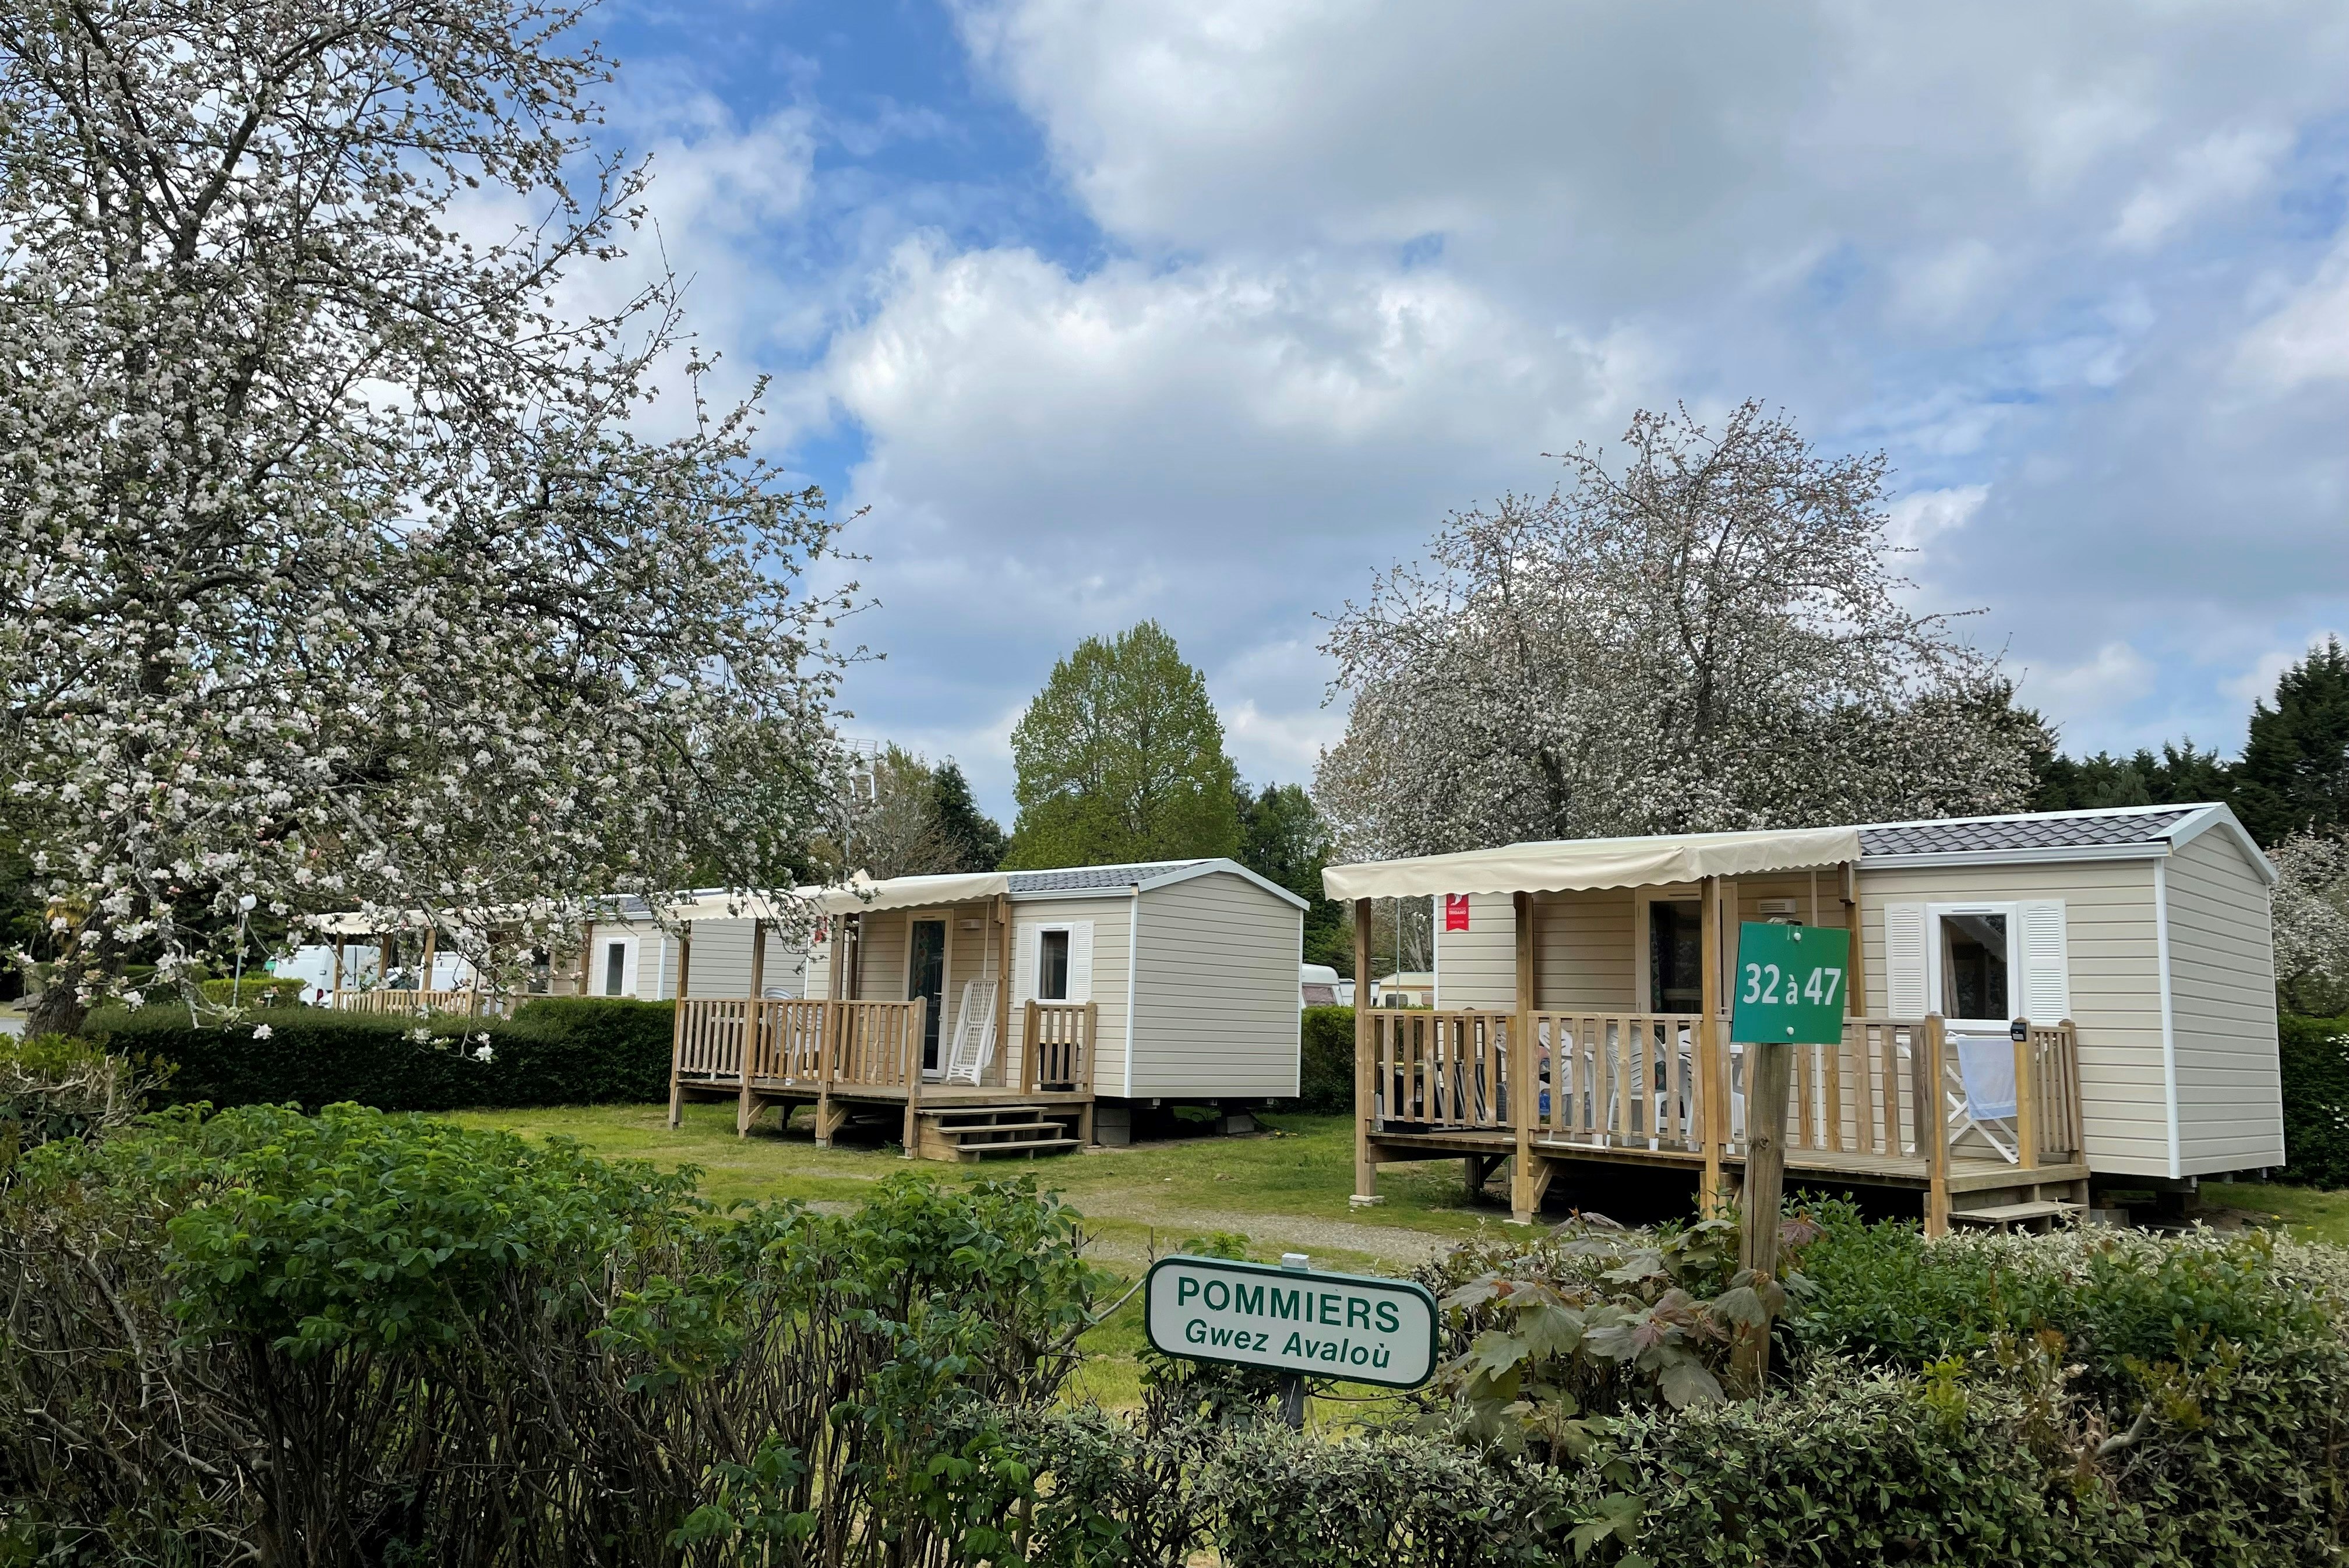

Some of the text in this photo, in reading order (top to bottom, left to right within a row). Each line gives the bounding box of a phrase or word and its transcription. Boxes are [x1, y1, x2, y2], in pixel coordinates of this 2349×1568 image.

[1743, 963, 1842, 1005] 32 à 47
[1178, 1276, 1400, 1333] POMMIERS
[1185, 1318, 1391, 1369] Gwez Avaloù
